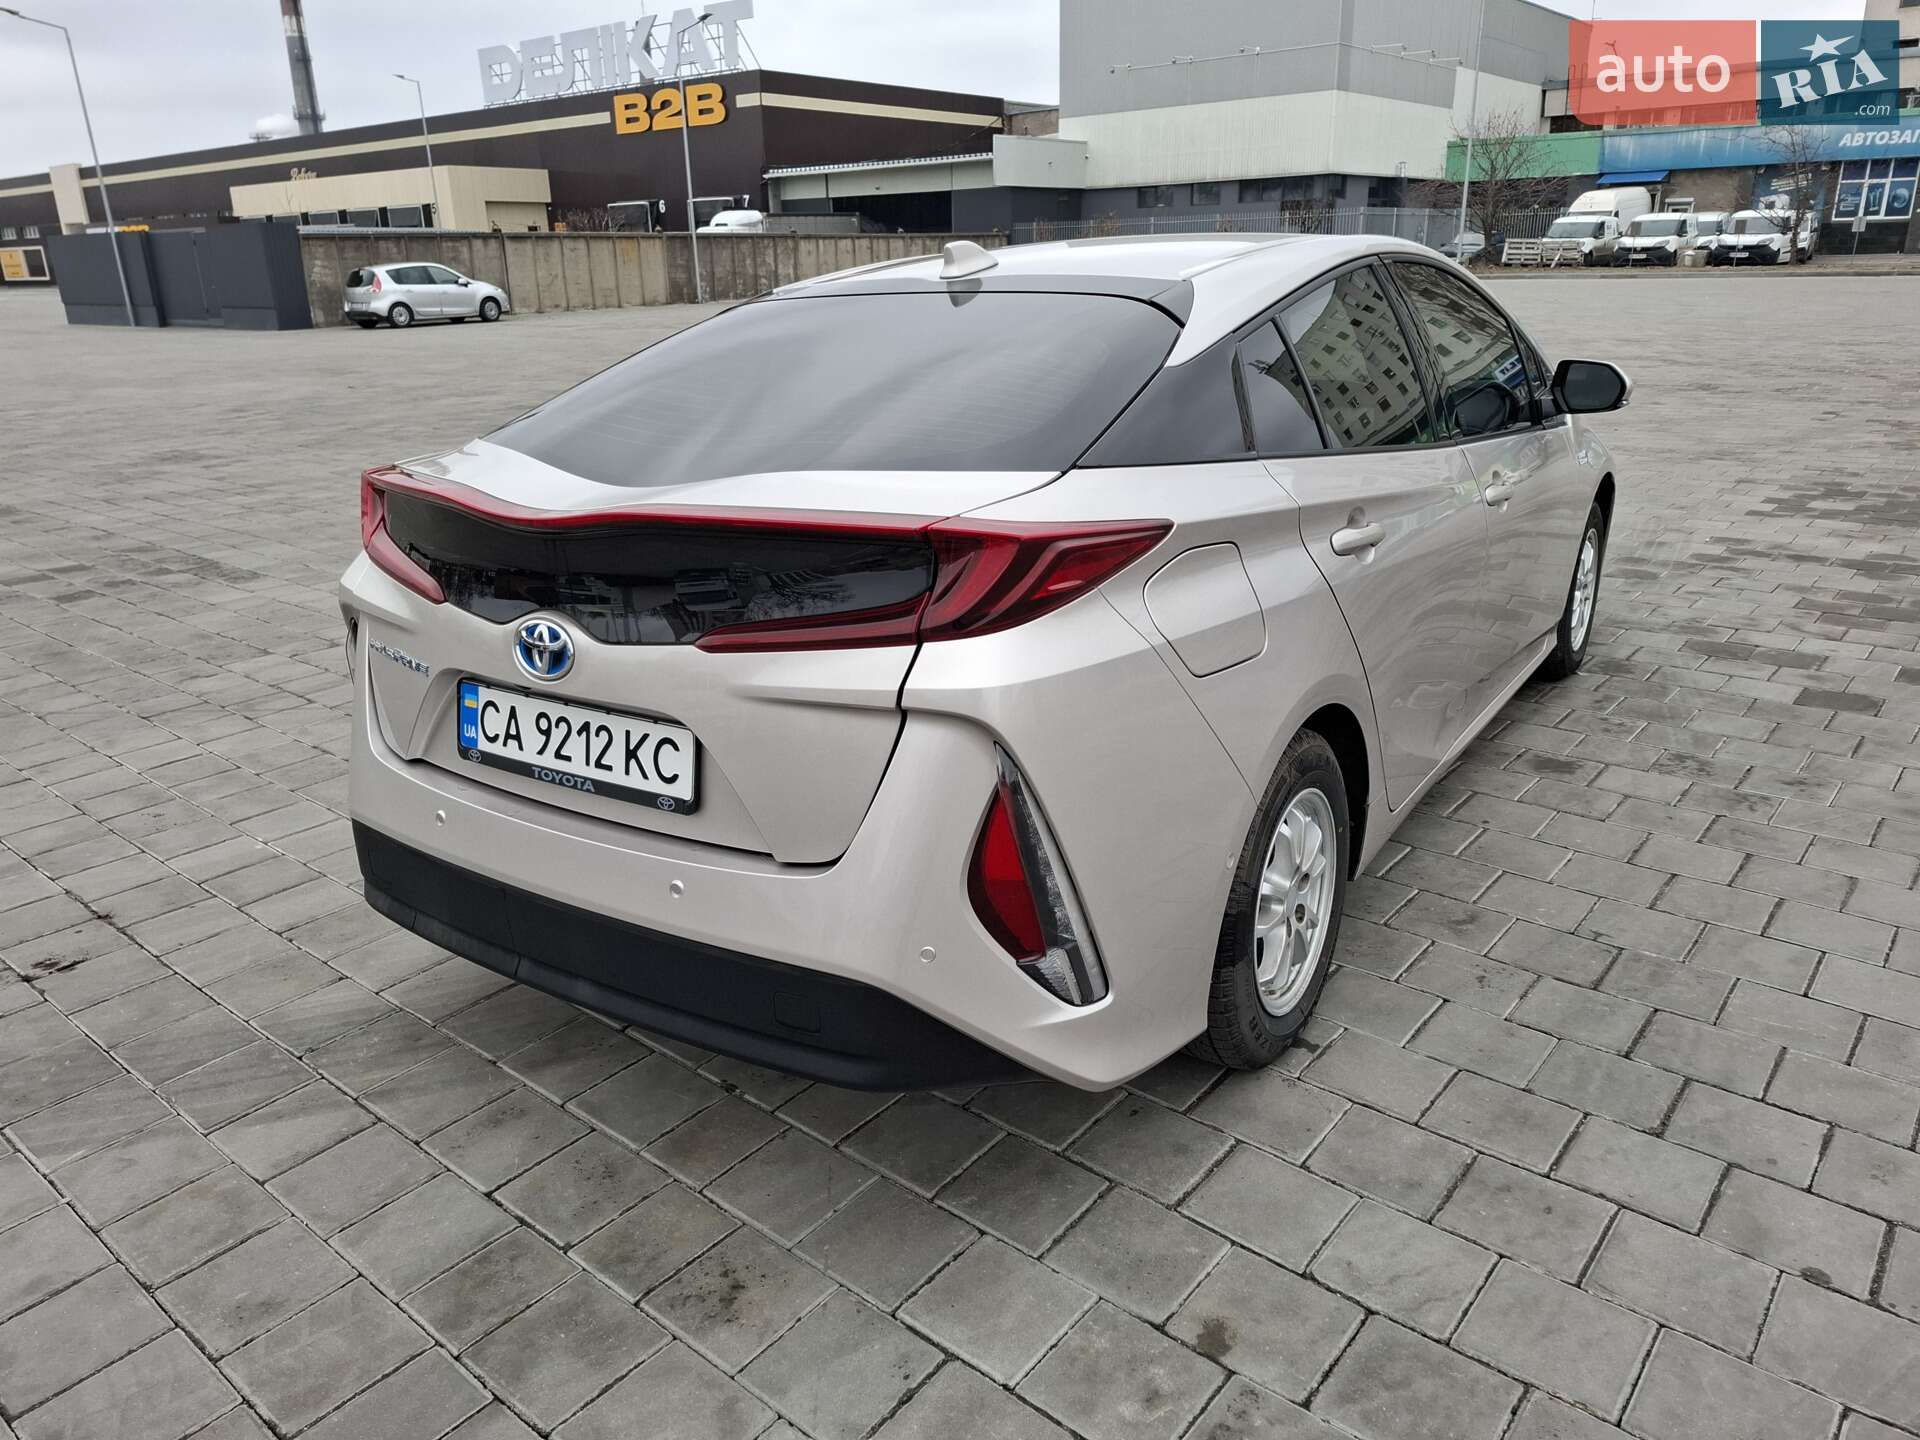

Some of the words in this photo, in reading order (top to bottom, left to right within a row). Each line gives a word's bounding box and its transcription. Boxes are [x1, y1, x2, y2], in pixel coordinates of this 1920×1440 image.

[613, 82, 726, 135] B2B
[658, 200, 666, 213] 6
[742, 194, 750, 208] 7
[464, 723, 477, 739] UA
[480, 700, 524, 752] CA
[534, 711, 614, 772] 9212
[624, 729, 681, 785] KC
[531, 766, 596, 793] TOYOTA
